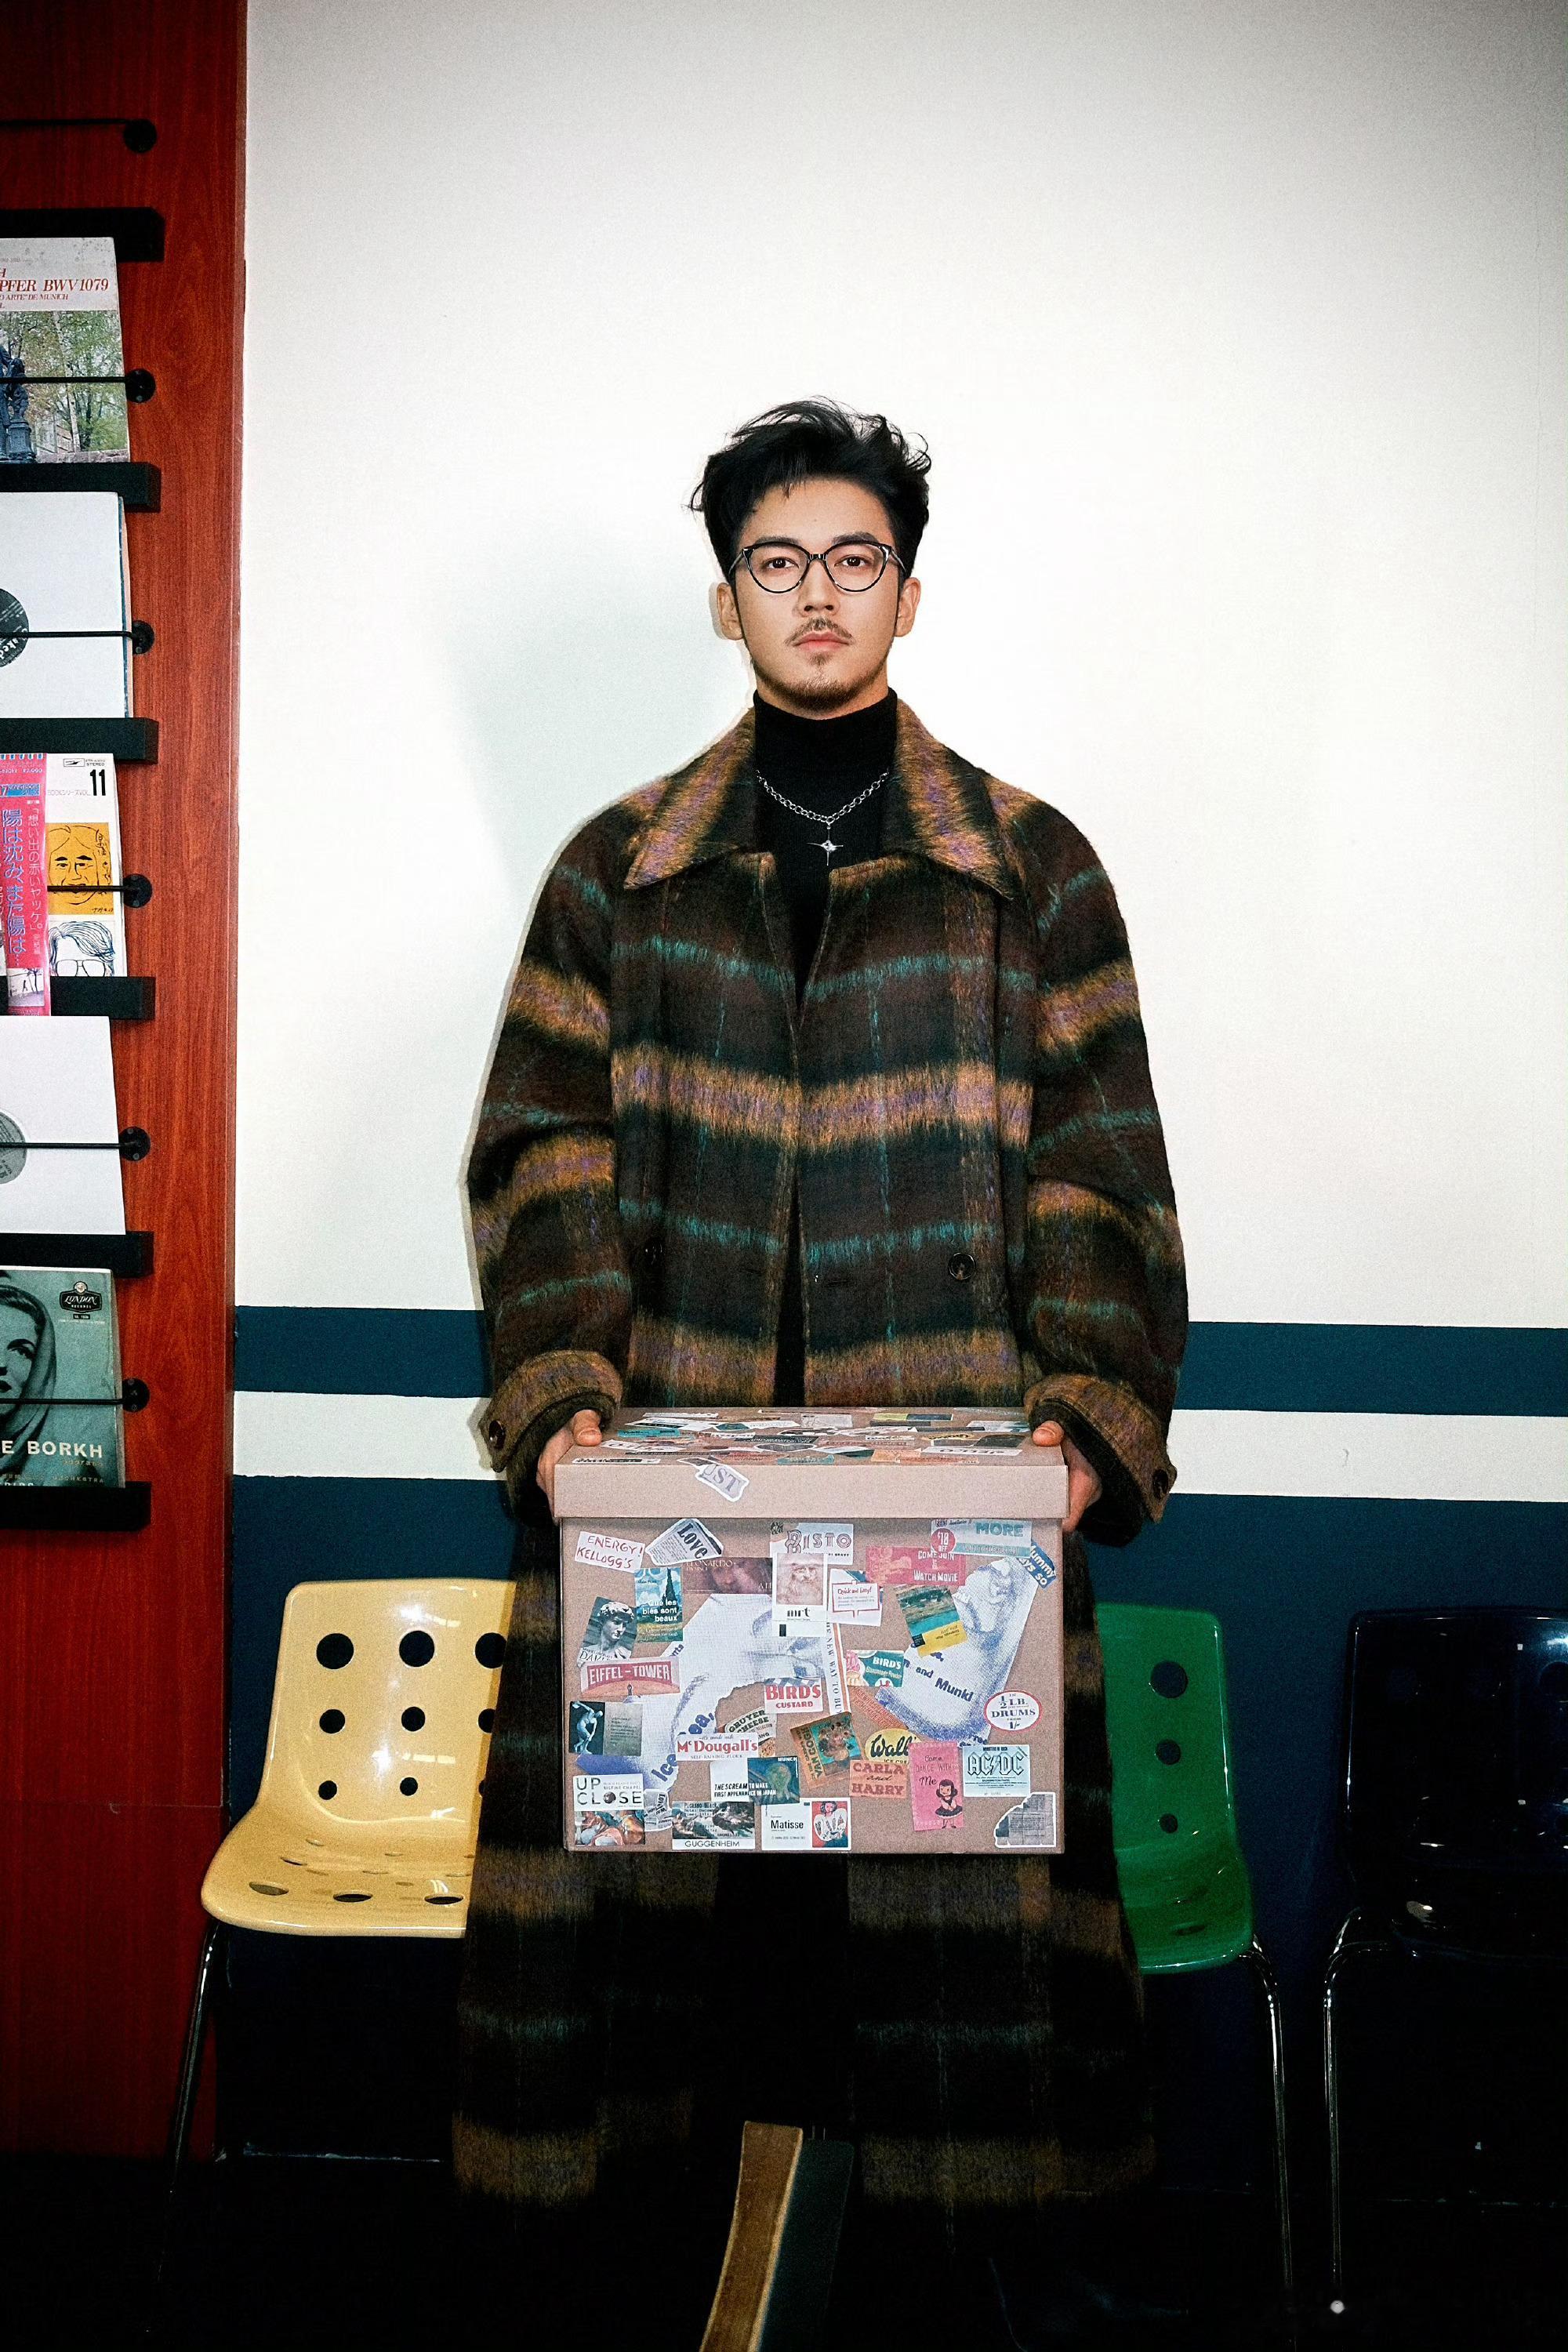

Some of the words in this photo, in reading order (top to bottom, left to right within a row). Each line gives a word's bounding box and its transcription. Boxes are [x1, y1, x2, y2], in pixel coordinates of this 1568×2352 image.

[43, 279, 78, 292] BWV
[78, 278, 109, 292] 1079
[89, 769, 106, 796] 11
[64, 1295, 97, 1305] LONDON
[27, 1441, 103, 1458] BORKH
[975, 1523, 1024, 1537] MORE
[918, 1551, 937, 1559] COME
[1035, 1573, 1047, 1584] so
[590, 1666, 623, 1685] EIFFEL
[633, 1664, 670, 1680] TOWER
[916, 1667, 934, 1678] and
[833, 1682, 840, 1694] TO
[991, 1708, 1036, 1718] DRUMS
[811, 1756, 822, 1777] VAN
[853, 1762, 905, 1775] CARLA
[576, 1777, 601, 1790] UP
[919, 1776, 937, 1786] Me
[851, 1783, 904, 1795] HARRY
[771, 1820, 804, 1829] Matisse
